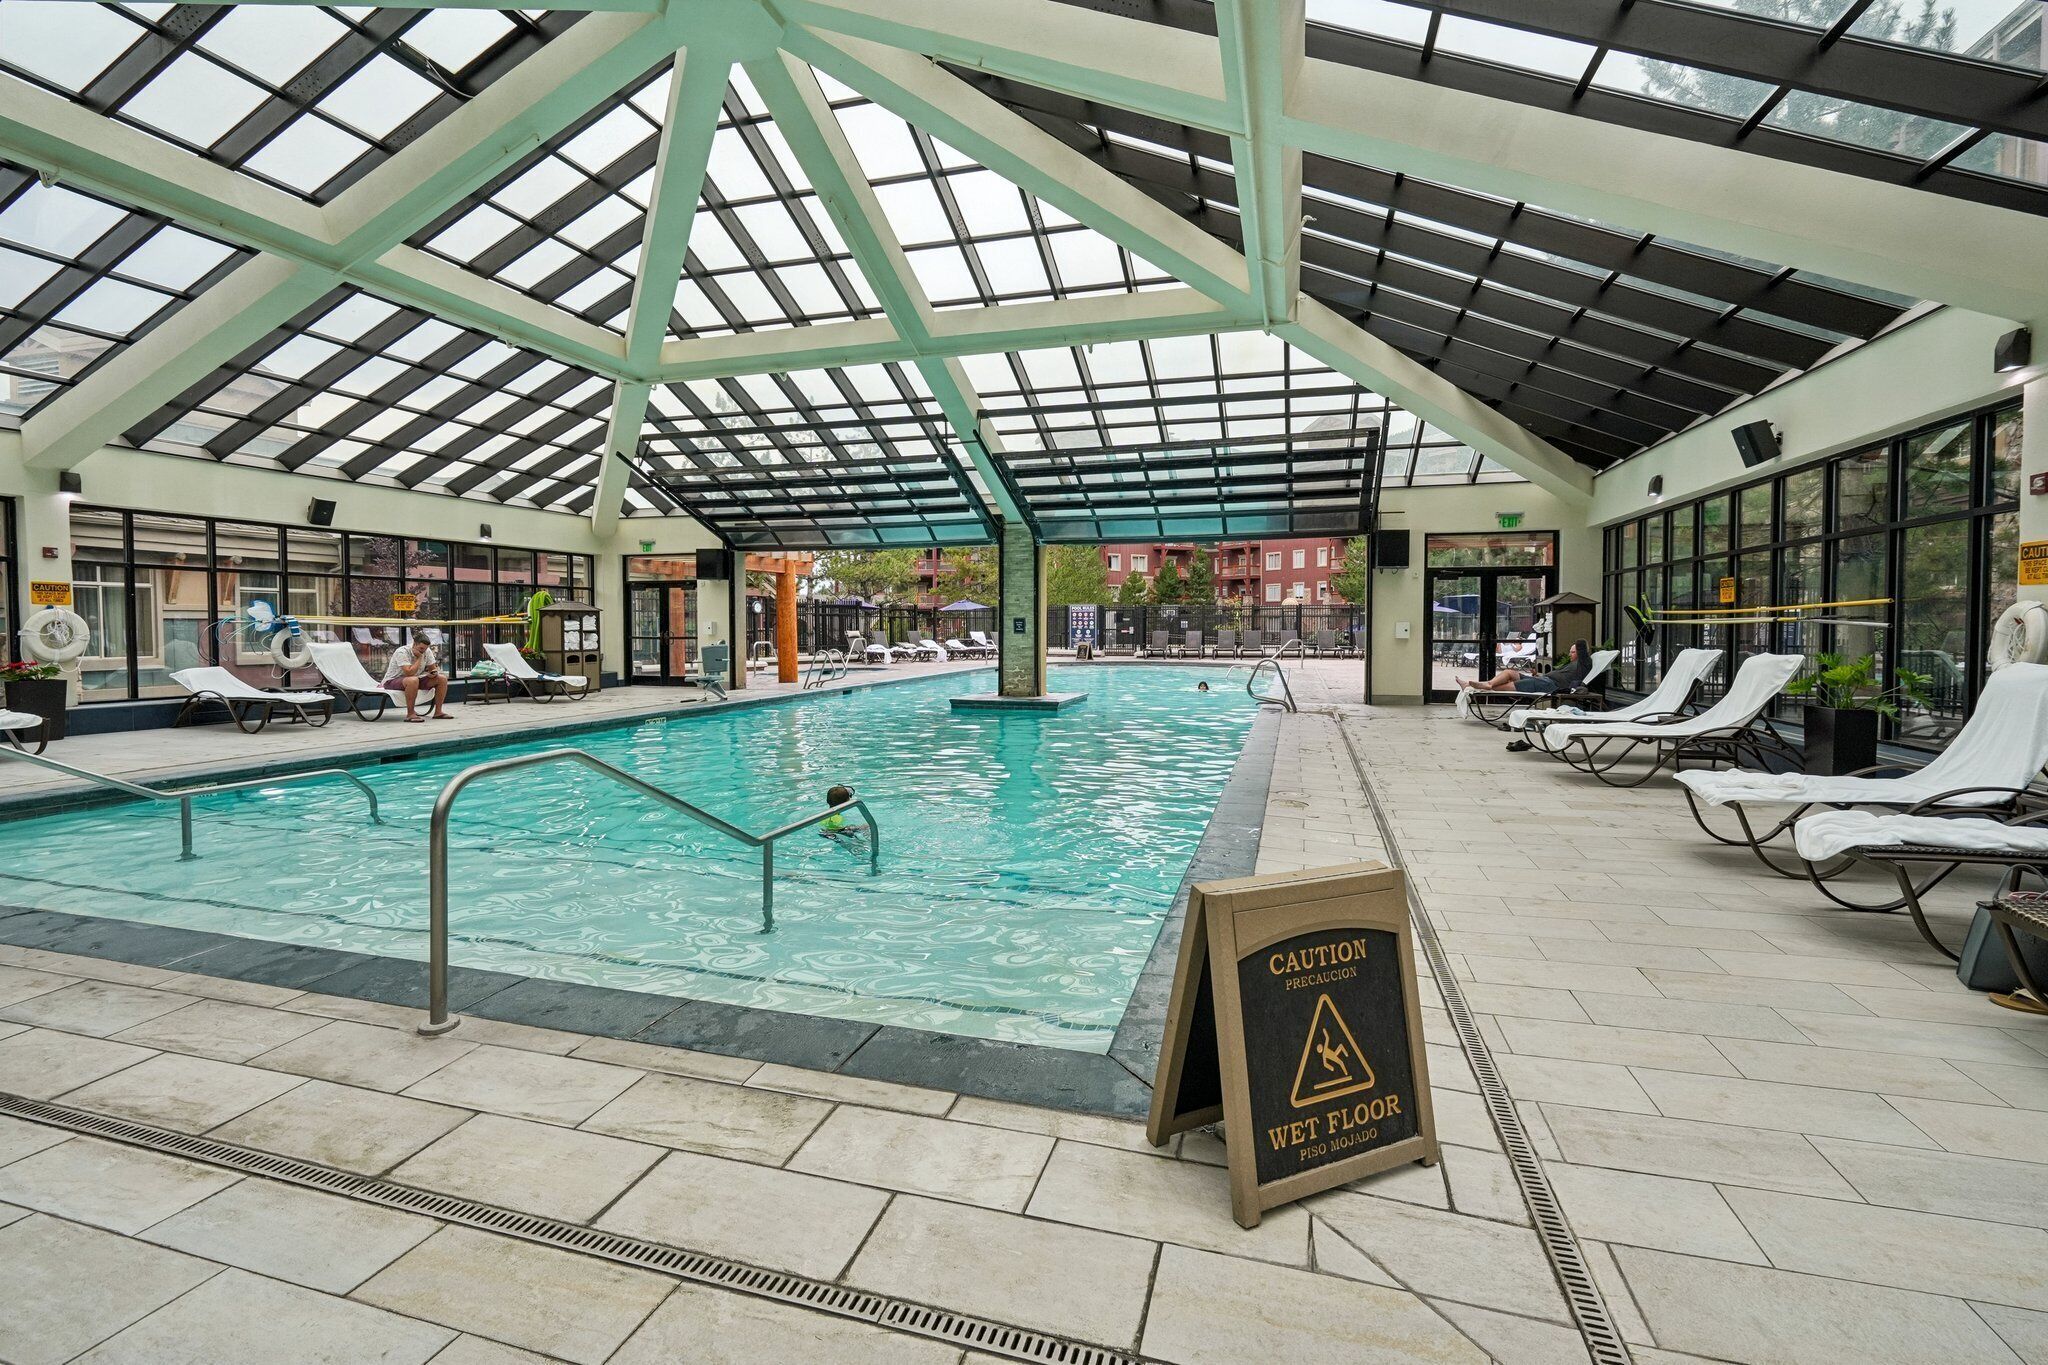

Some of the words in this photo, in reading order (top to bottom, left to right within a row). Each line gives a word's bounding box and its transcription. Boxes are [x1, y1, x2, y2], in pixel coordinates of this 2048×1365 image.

[1269, 939, 1367, 976] CAUTION
[1285, 966, 1358, 990] PRECAUCION
[1268, 1117, 1320, 1150] WET
[1327, 1094, 1402, 1135] FLOOR
[1300, 1143, 1327, 1161] PISO
[1330, 1128, 1378, 1152] MOJADO
